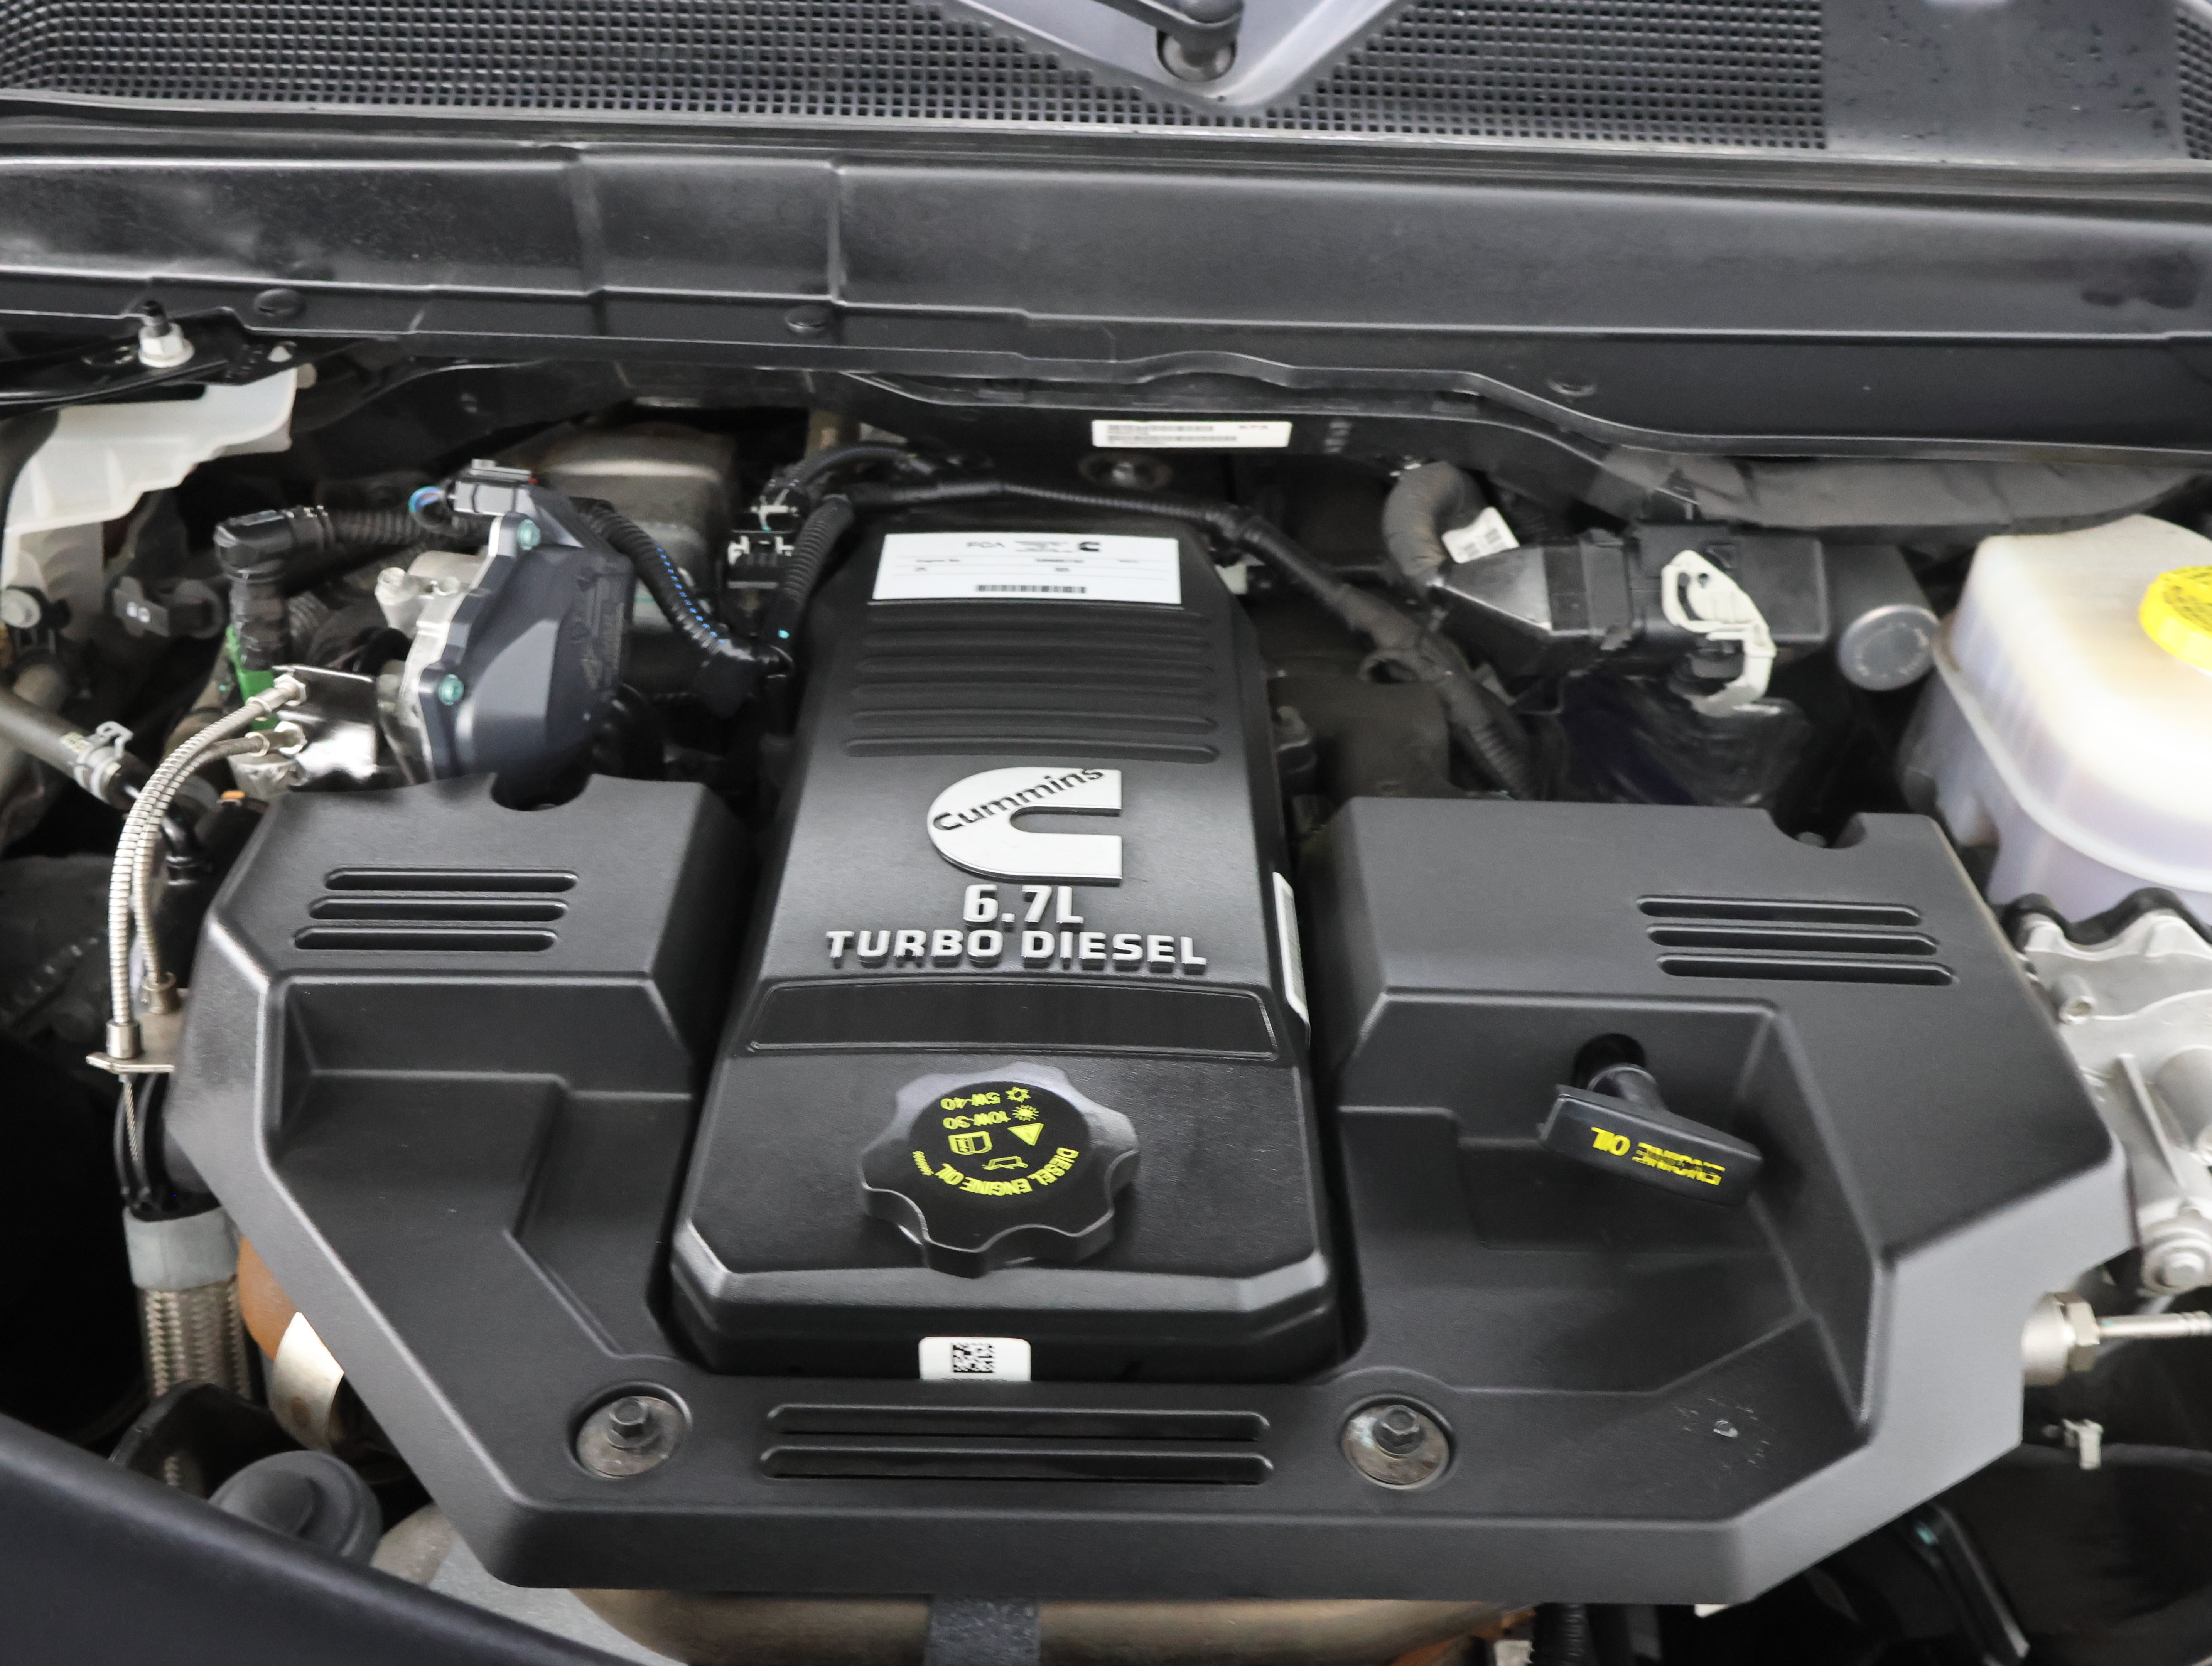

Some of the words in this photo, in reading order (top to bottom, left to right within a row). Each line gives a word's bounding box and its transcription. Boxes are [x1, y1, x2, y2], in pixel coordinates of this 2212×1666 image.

[933, 769, 1104, 830] Cummins
[963, 884, 1084, 924] 6.7L
[825, 929, 1004, 961] TURBO
[1020, 930, 1207, 965] DIESEL
[940, 1092, 1001, 1111] 5W-40
[943, 1111, 1011, 1130] 10W-30
[1590, 1126, 1631, 1156] OIL
[934, 1162, 965, 1185] OIL
[1026, 1147, 1080, 1186] DIESEL
[958, 1176, 1033, 1196] ENGINE
